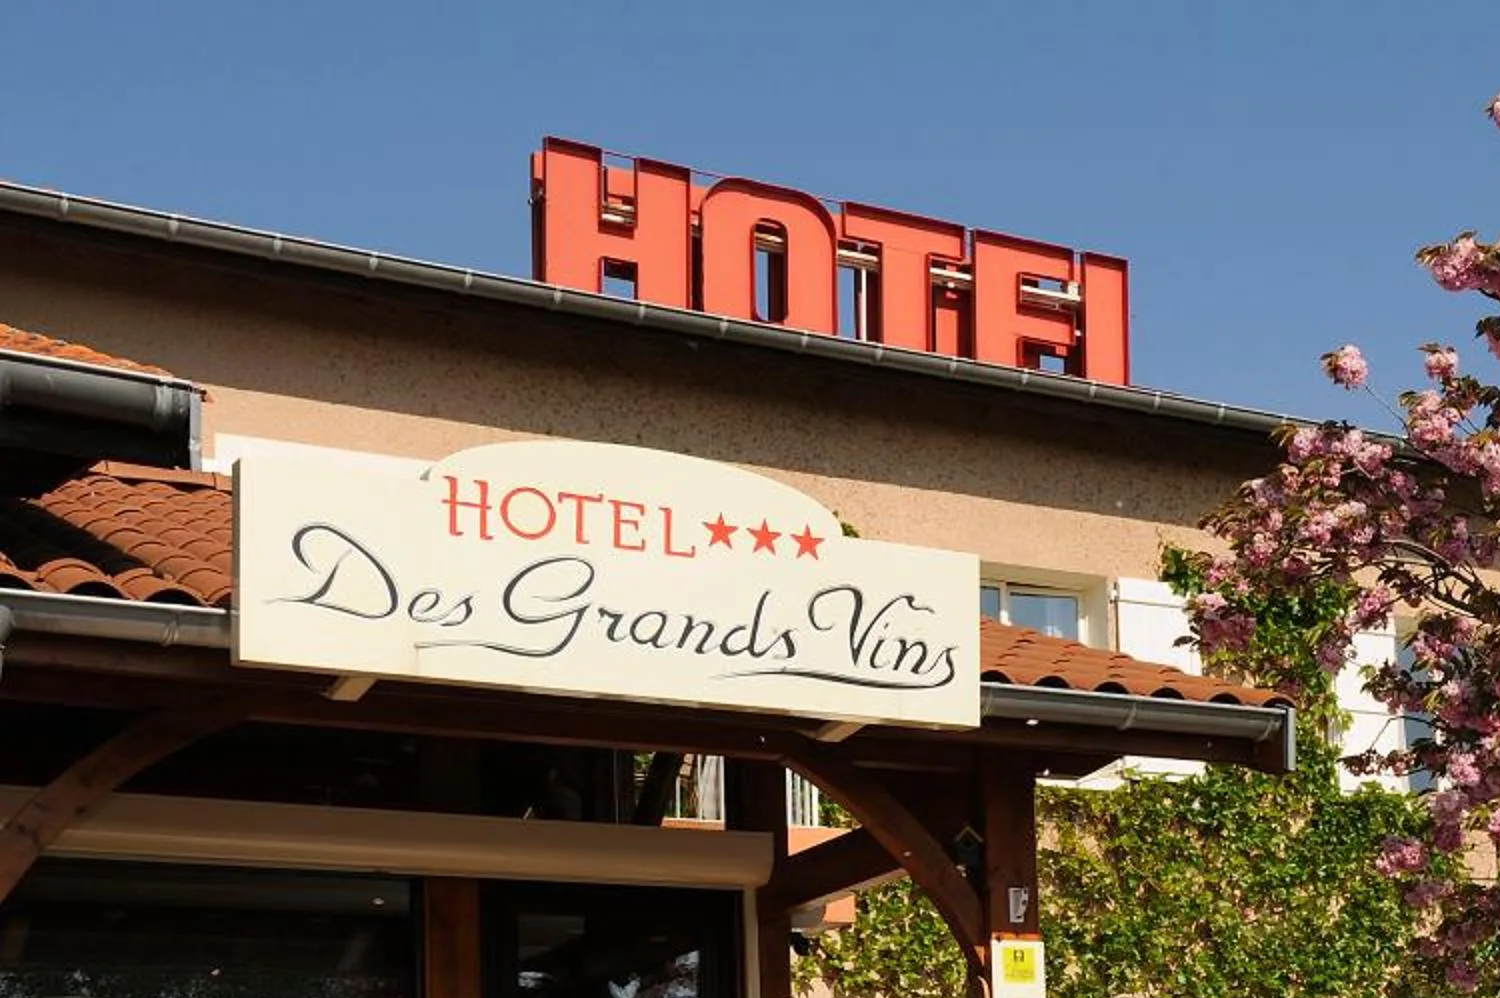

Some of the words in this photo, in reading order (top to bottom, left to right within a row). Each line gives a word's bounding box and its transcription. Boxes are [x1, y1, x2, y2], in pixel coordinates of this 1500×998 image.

[441, 475, 696, 558] HOTEL
[264, 522, 474, 627] Des
[414, 556, 798, 658] Grands
[807, 584, 960, 689] Vins
